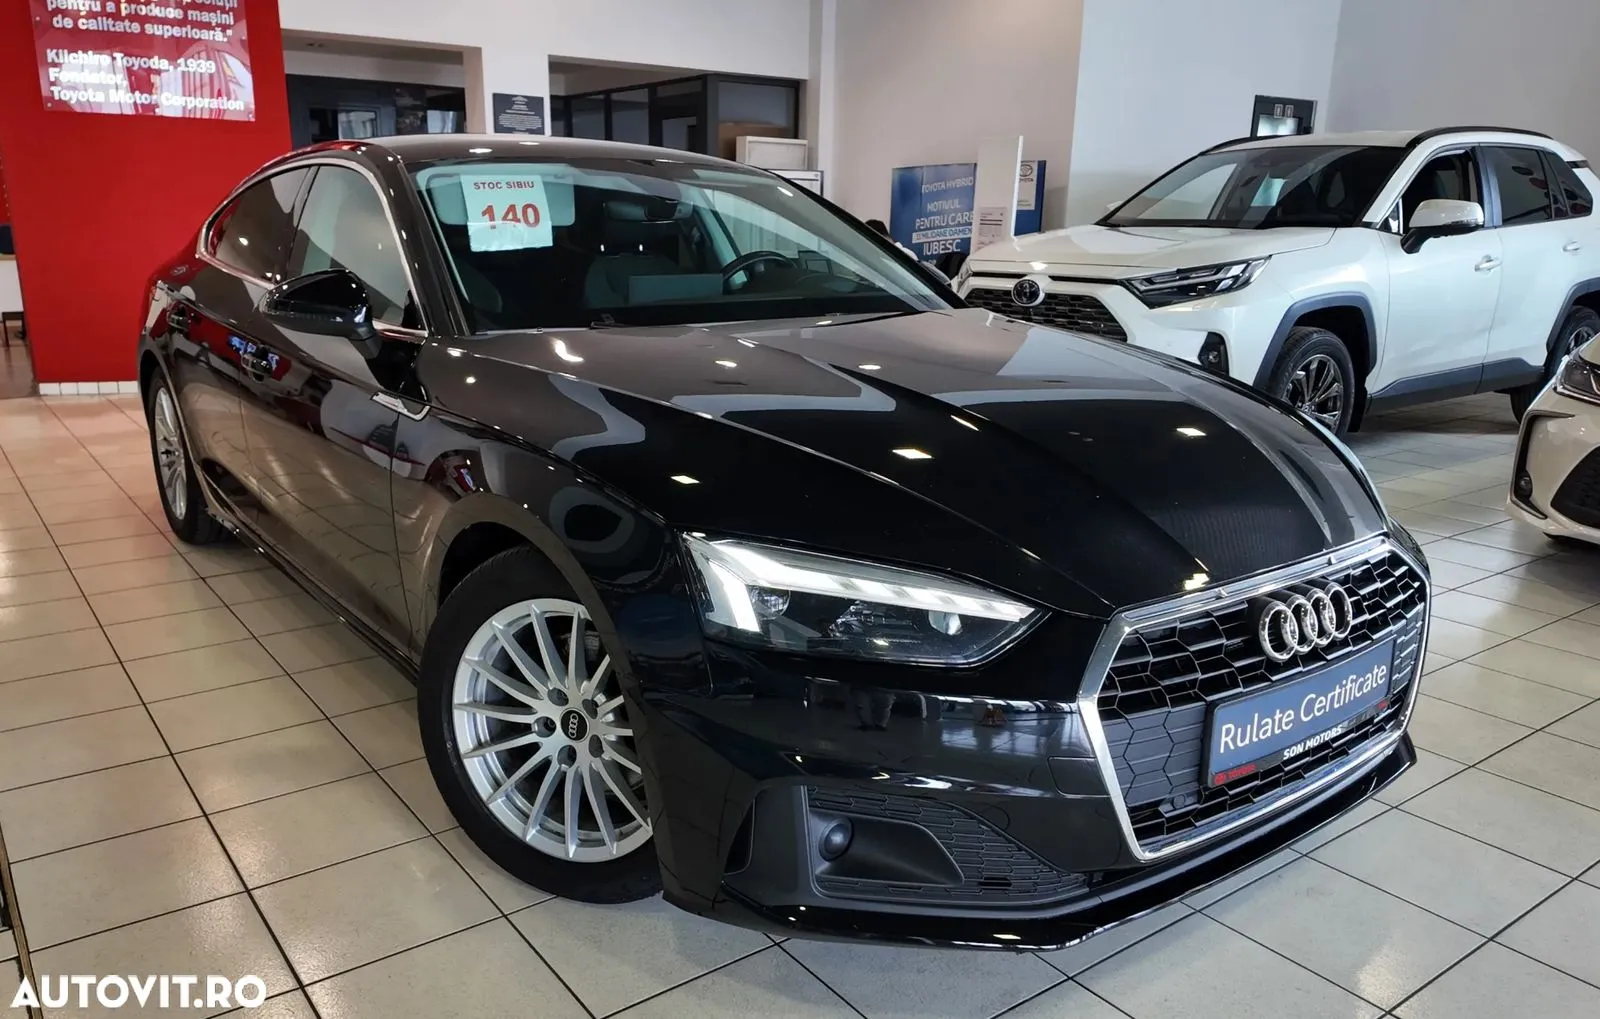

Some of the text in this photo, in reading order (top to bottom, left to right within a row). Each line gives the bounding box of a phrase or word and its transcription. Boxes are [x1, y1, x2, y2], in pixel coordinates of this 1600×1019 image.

[105, 1, 116, 13] a
[120, 2, 184, 19] produce
[52, 14, 74, 28] de
[77, 16, 141, 33] calitate
[46, 48, 216, 74] Kiichiro Toyoda, 1939
[50, 85, 245, 111] Toyota Motor Corporation
[473, 181, 535, 190] STOC SIBIU
[922, 176, 974, 193] TOYOTA HYBRID
[927, 199, 961, 213] MOTIVUL
[481, 203, 541, 230] 140
[915, 215, 947, 230] PENTRU
[923, 240, 961, 256] IUBESC
[1219, 664, 1388, 754] Rulate Certificate
[1282, 724, 1343, 760] SON MOTORS
